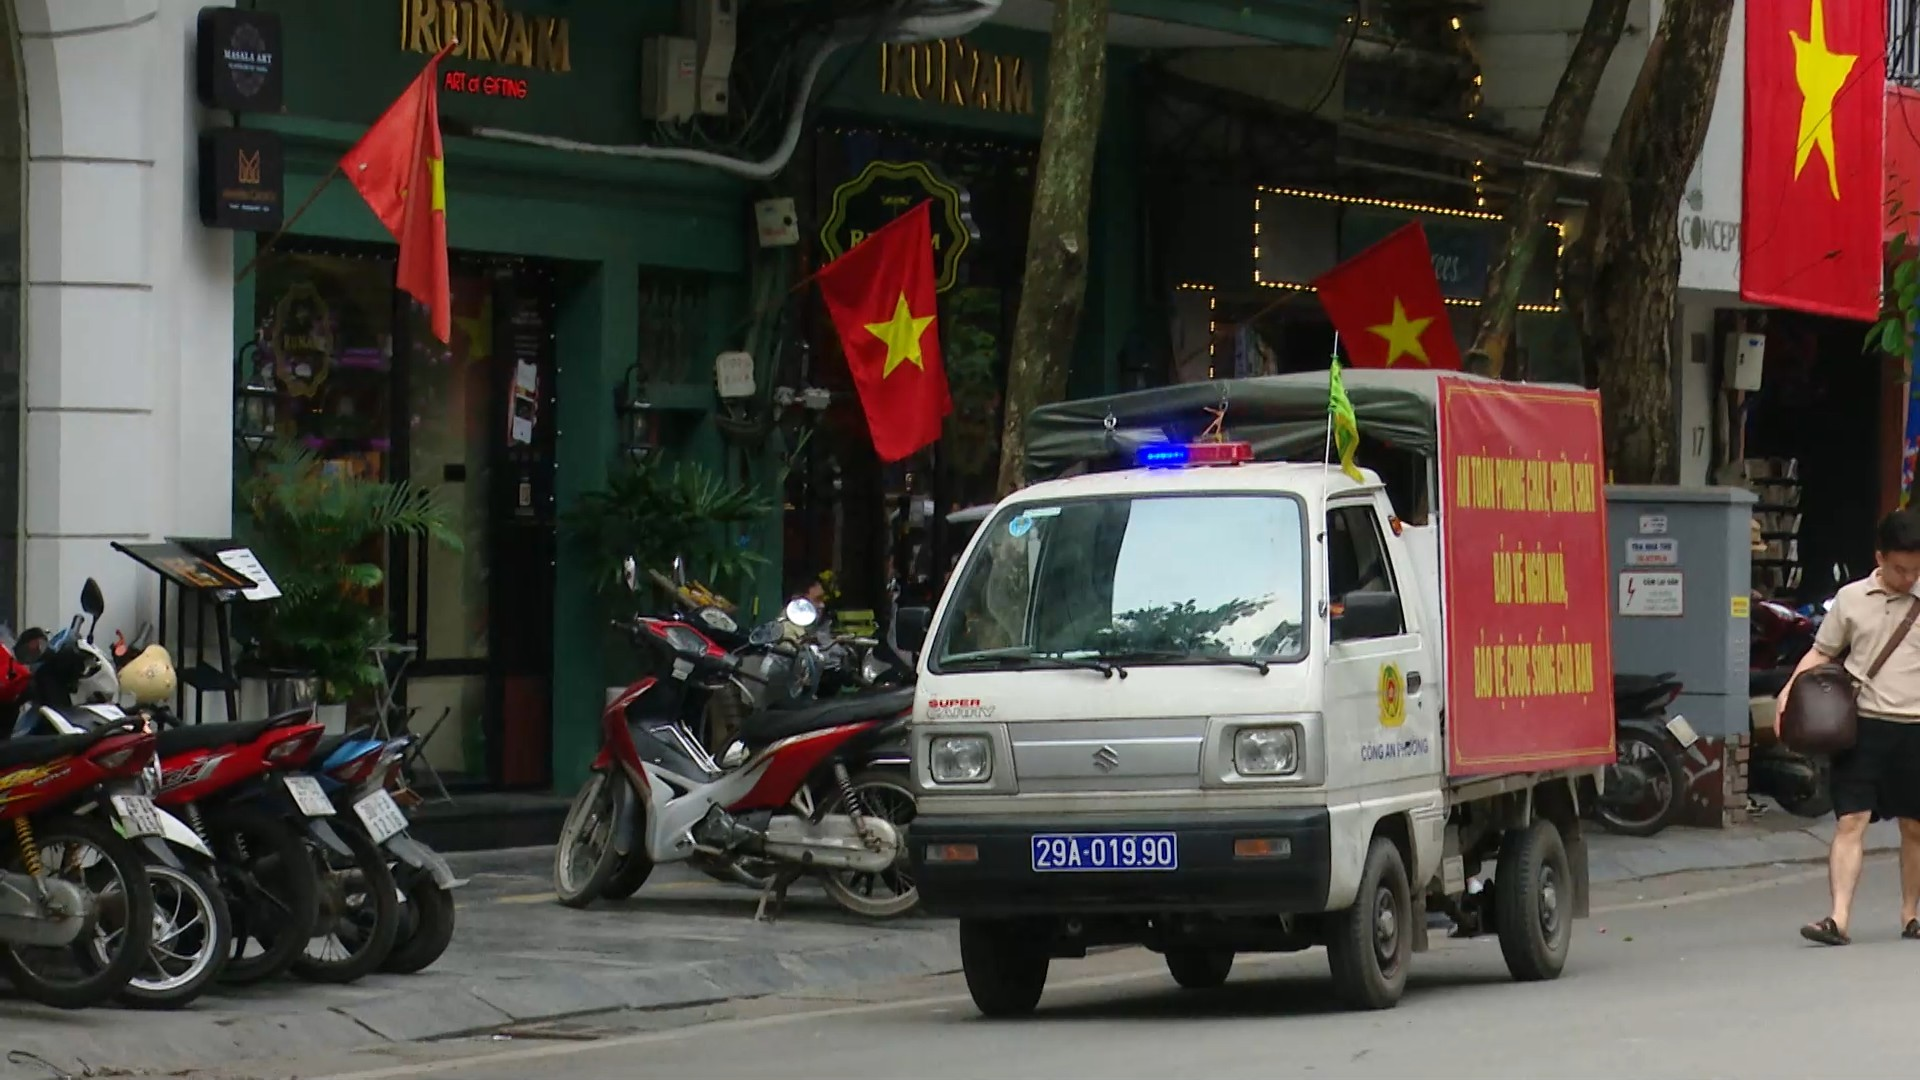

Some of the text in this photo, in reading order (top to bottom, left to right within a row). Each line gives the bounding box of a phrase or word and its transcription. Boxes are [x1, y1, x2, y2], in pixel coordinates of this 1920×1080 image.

[257, 53, 273, 63] ART
[445, 71, 466, 92] ART
[483, 75, 529, 99] GIFTING
[1692, 426, 1705, 458] 17
[1457, 455, 1470, 509] AN
[1493, 533, 1512, 604] BẢO
[1474, 628, 1493, 698] BẢO
[927, 705, 996, 720] CARRY
[928, 699, 981, 709] SUPER
[1361, 741, 1384, 762] CÔNG
[1385, 743, 1396, 759] AN
[1036, 837, 1173, 867] 29A-019.90
